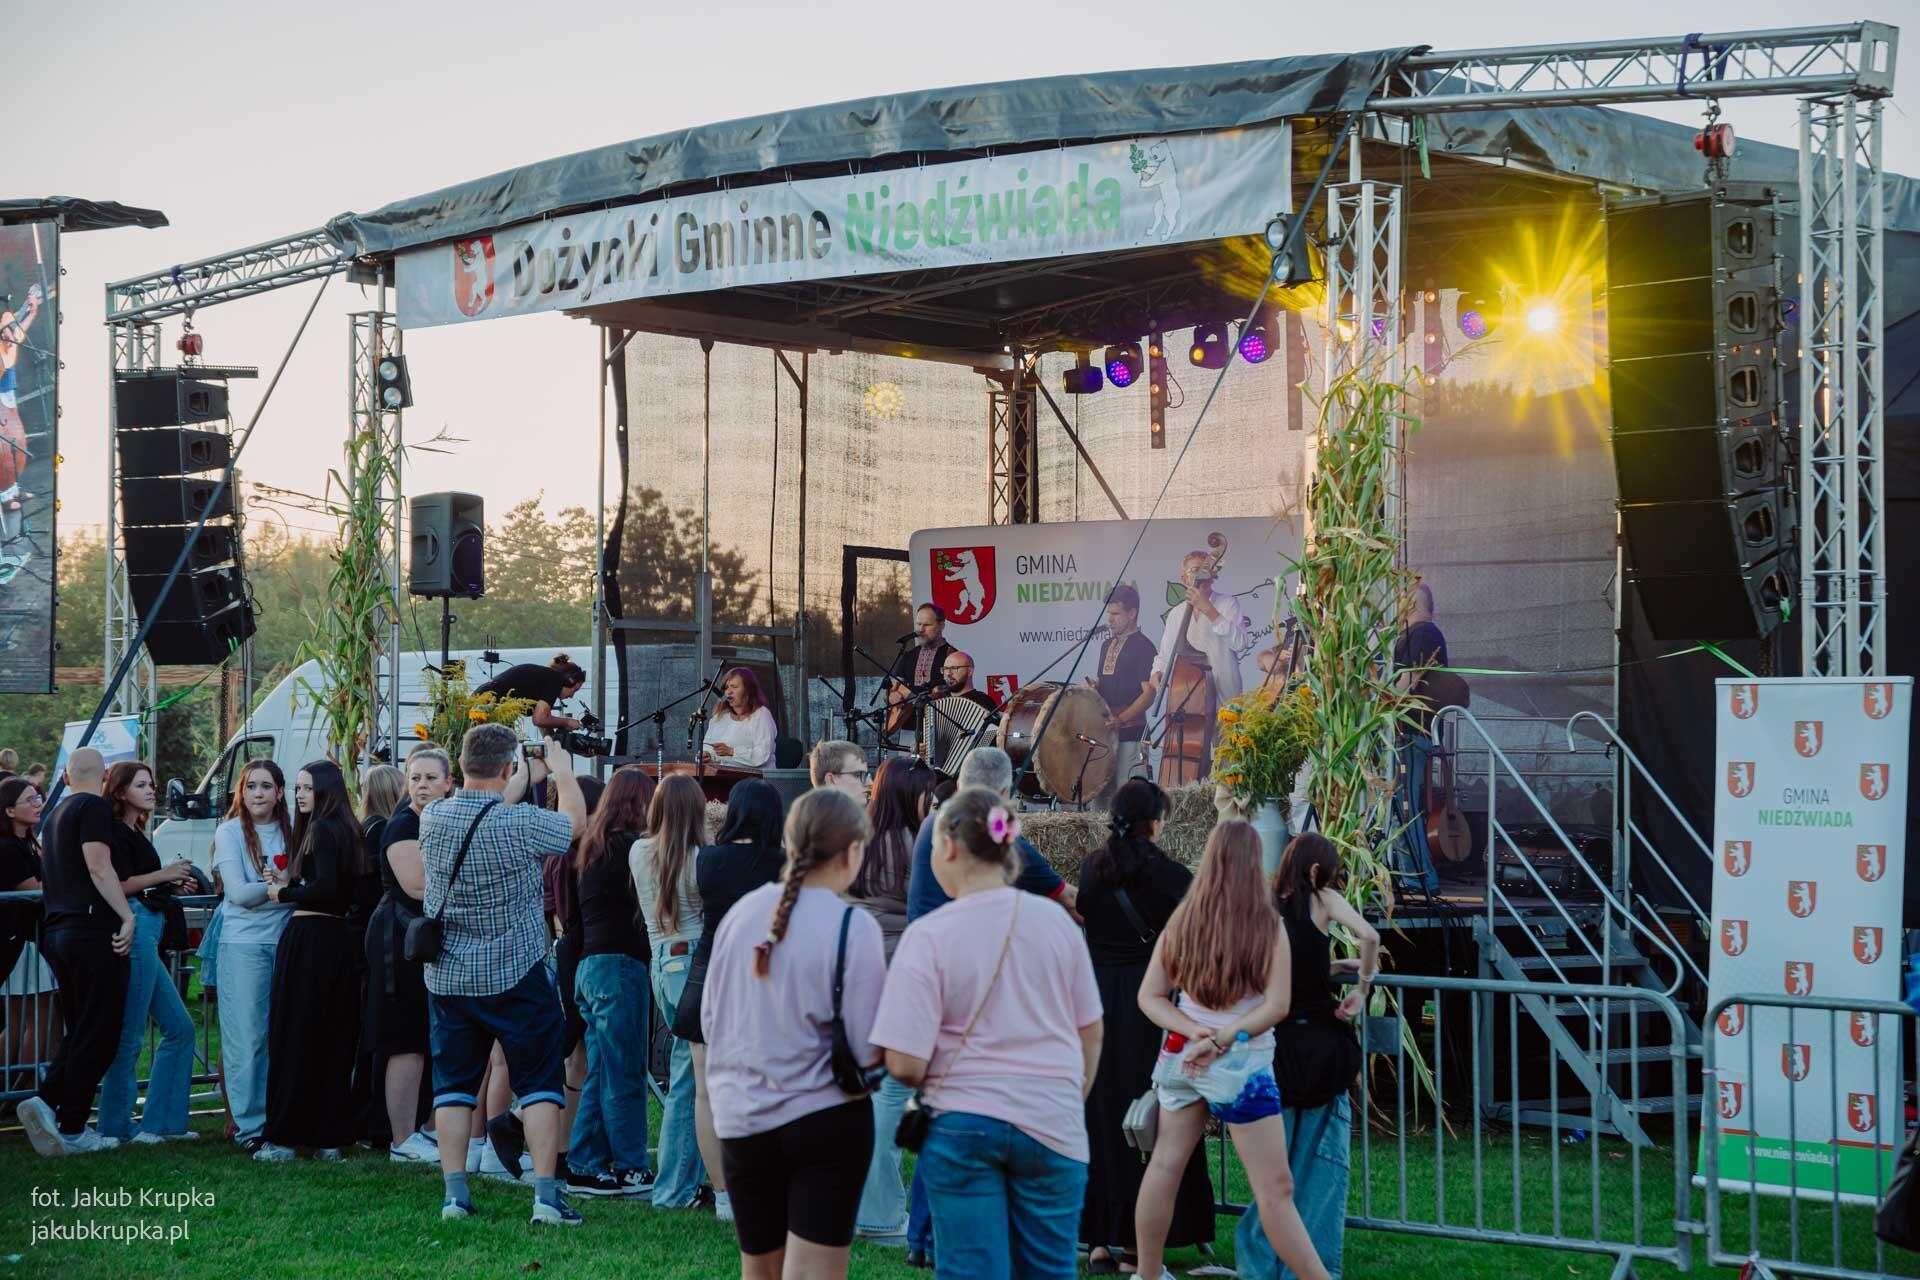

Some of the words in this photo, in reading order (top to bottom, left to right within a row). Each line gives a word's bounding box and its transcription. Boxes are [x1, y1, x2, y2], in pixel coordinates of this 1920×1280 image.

[511, 212, 659, 303] Dożynki
[675, 200, 832, 274] Gminne
[845, 162, 1121, 256] Niedźwiada
[1016, 554, 1077, 575] GMINA
[1017, 577, 1141, 603] NIEDŹWIAA
[1783, 788, 1830, 805] GMINA
[1758, 805, 1853, 828] NIEDŹWIADA
